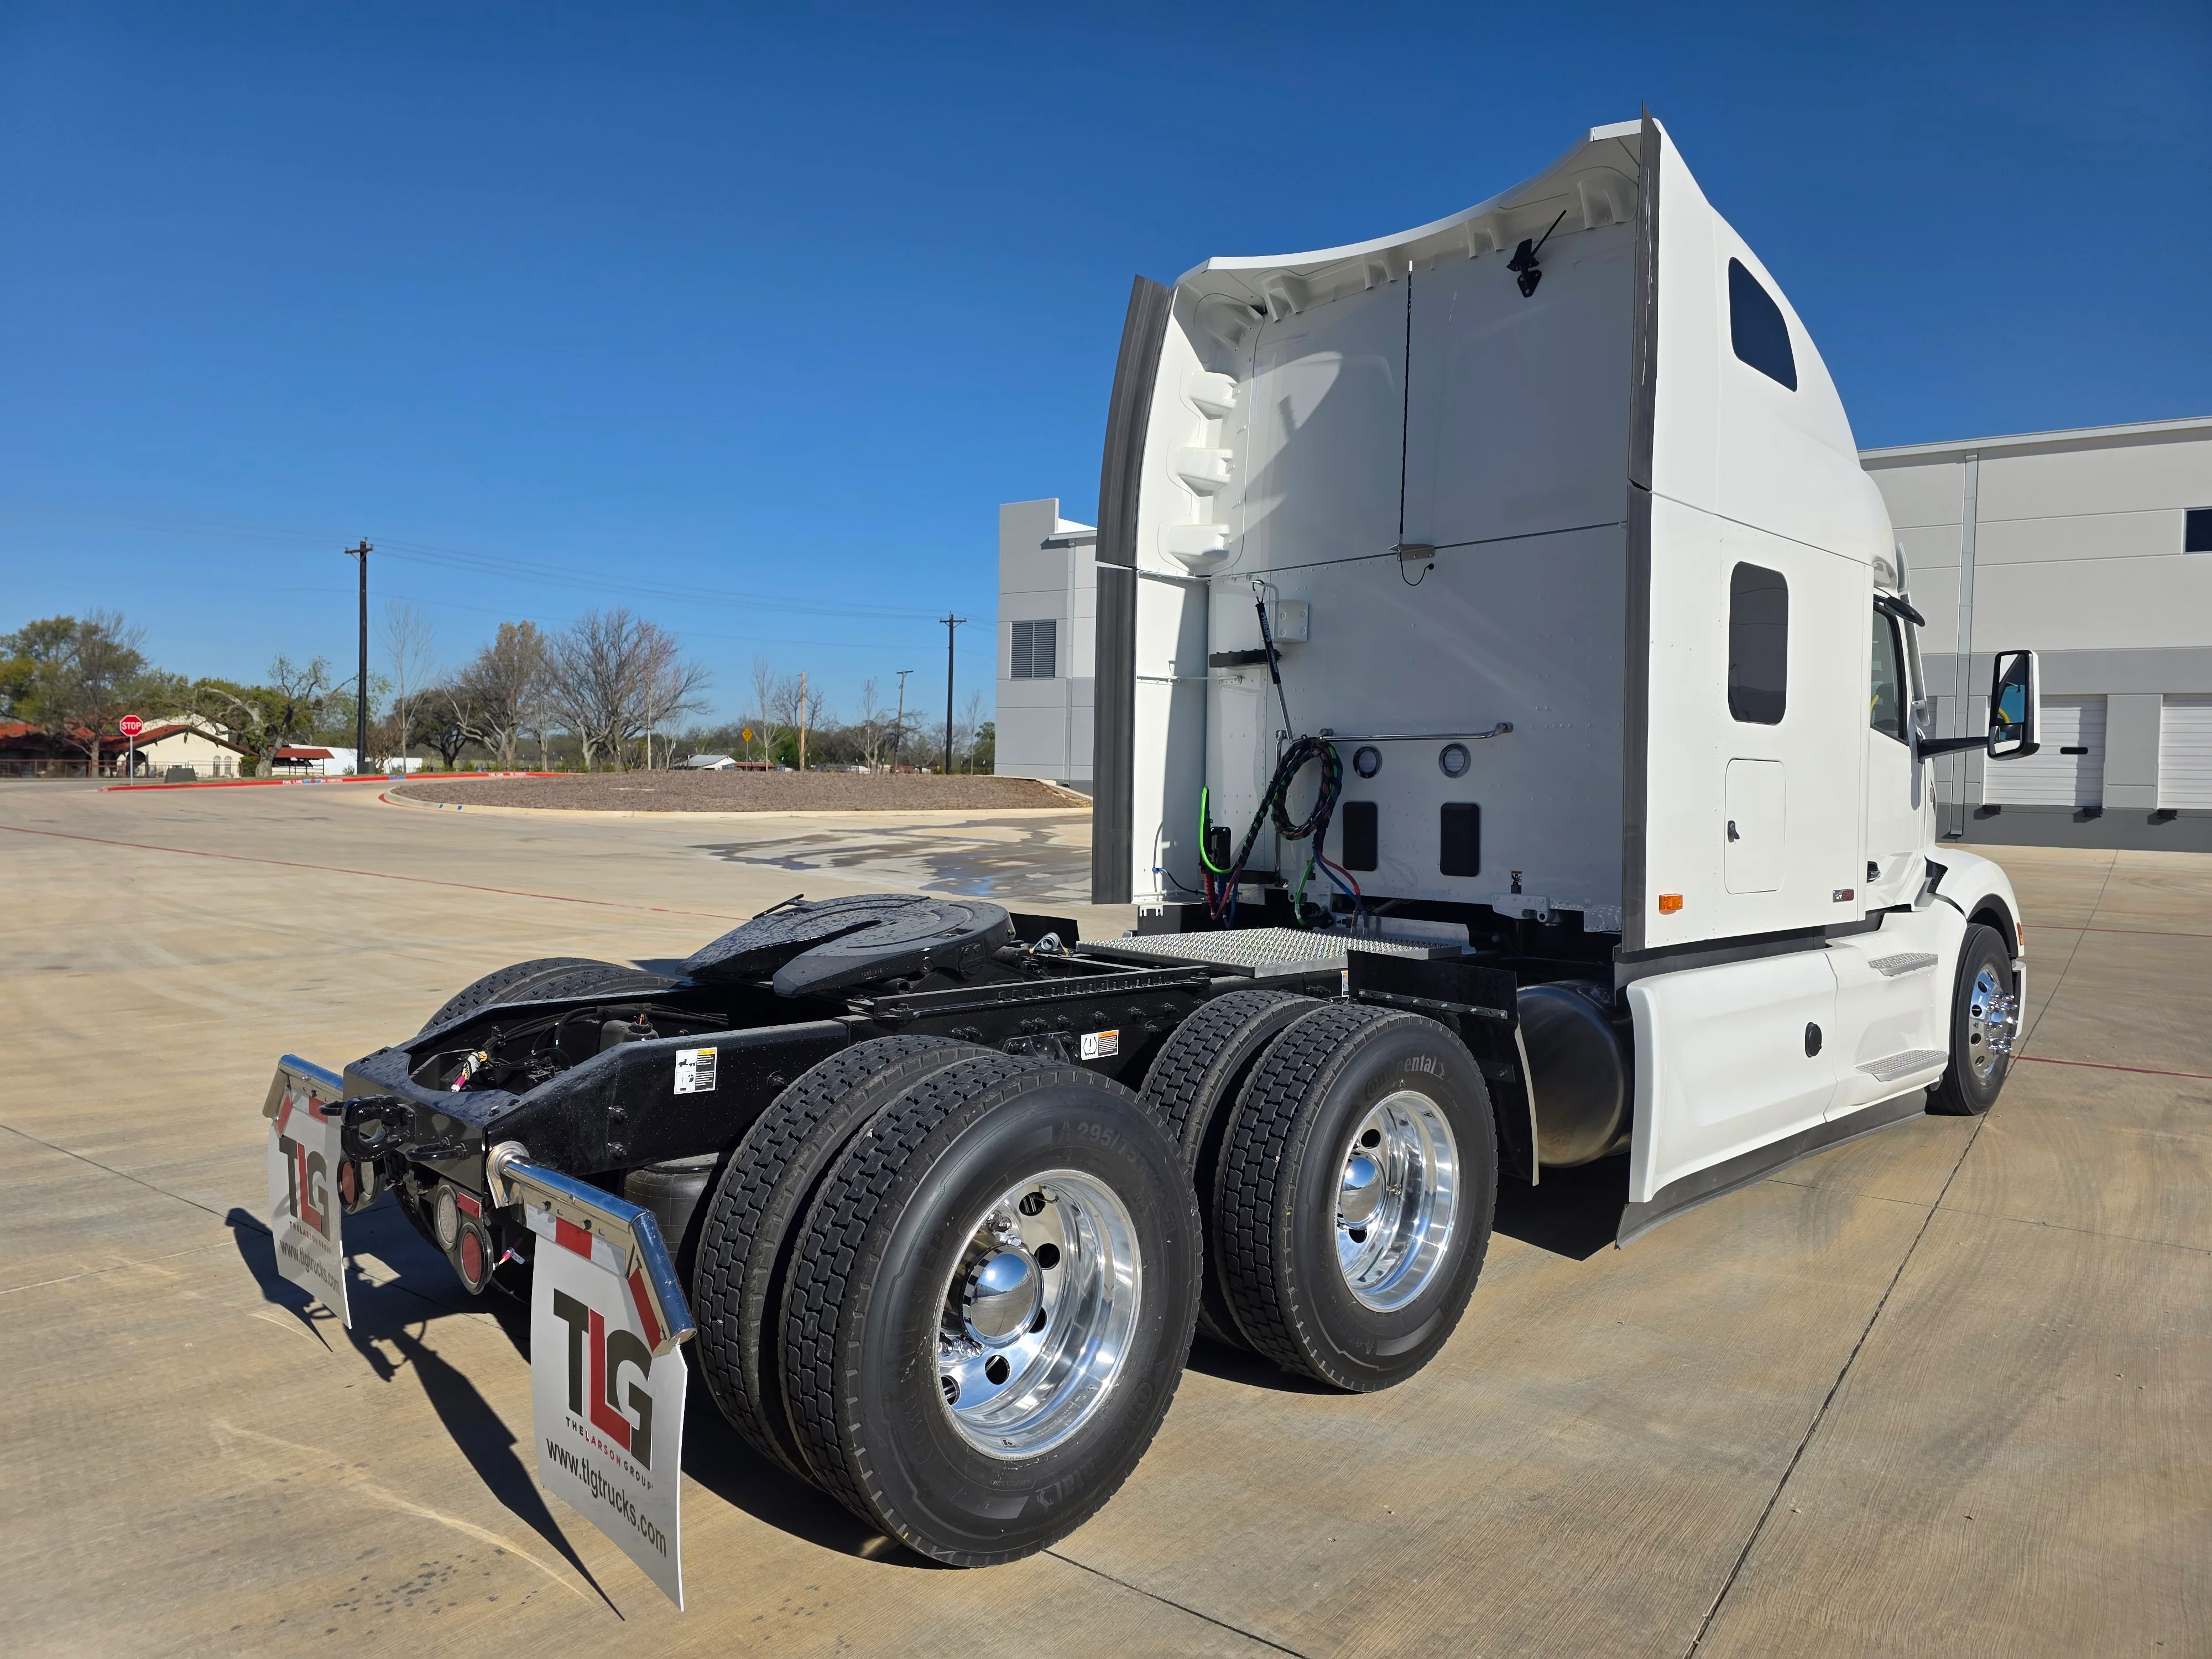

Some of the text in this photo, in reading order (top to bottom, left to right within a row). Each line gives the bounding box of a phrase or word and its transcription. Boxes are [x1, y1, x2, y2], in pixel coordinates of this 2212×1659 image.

[122, 721, 142, 731] STOP
[279, 1134, 331, 1242] TLG
[279, 1239, 341, 1296] www.tlgtrucks.com
[554, 1288, 653, 1472] TLG
[546, 1438, 667, 1558] www.tlgtrucks.com
